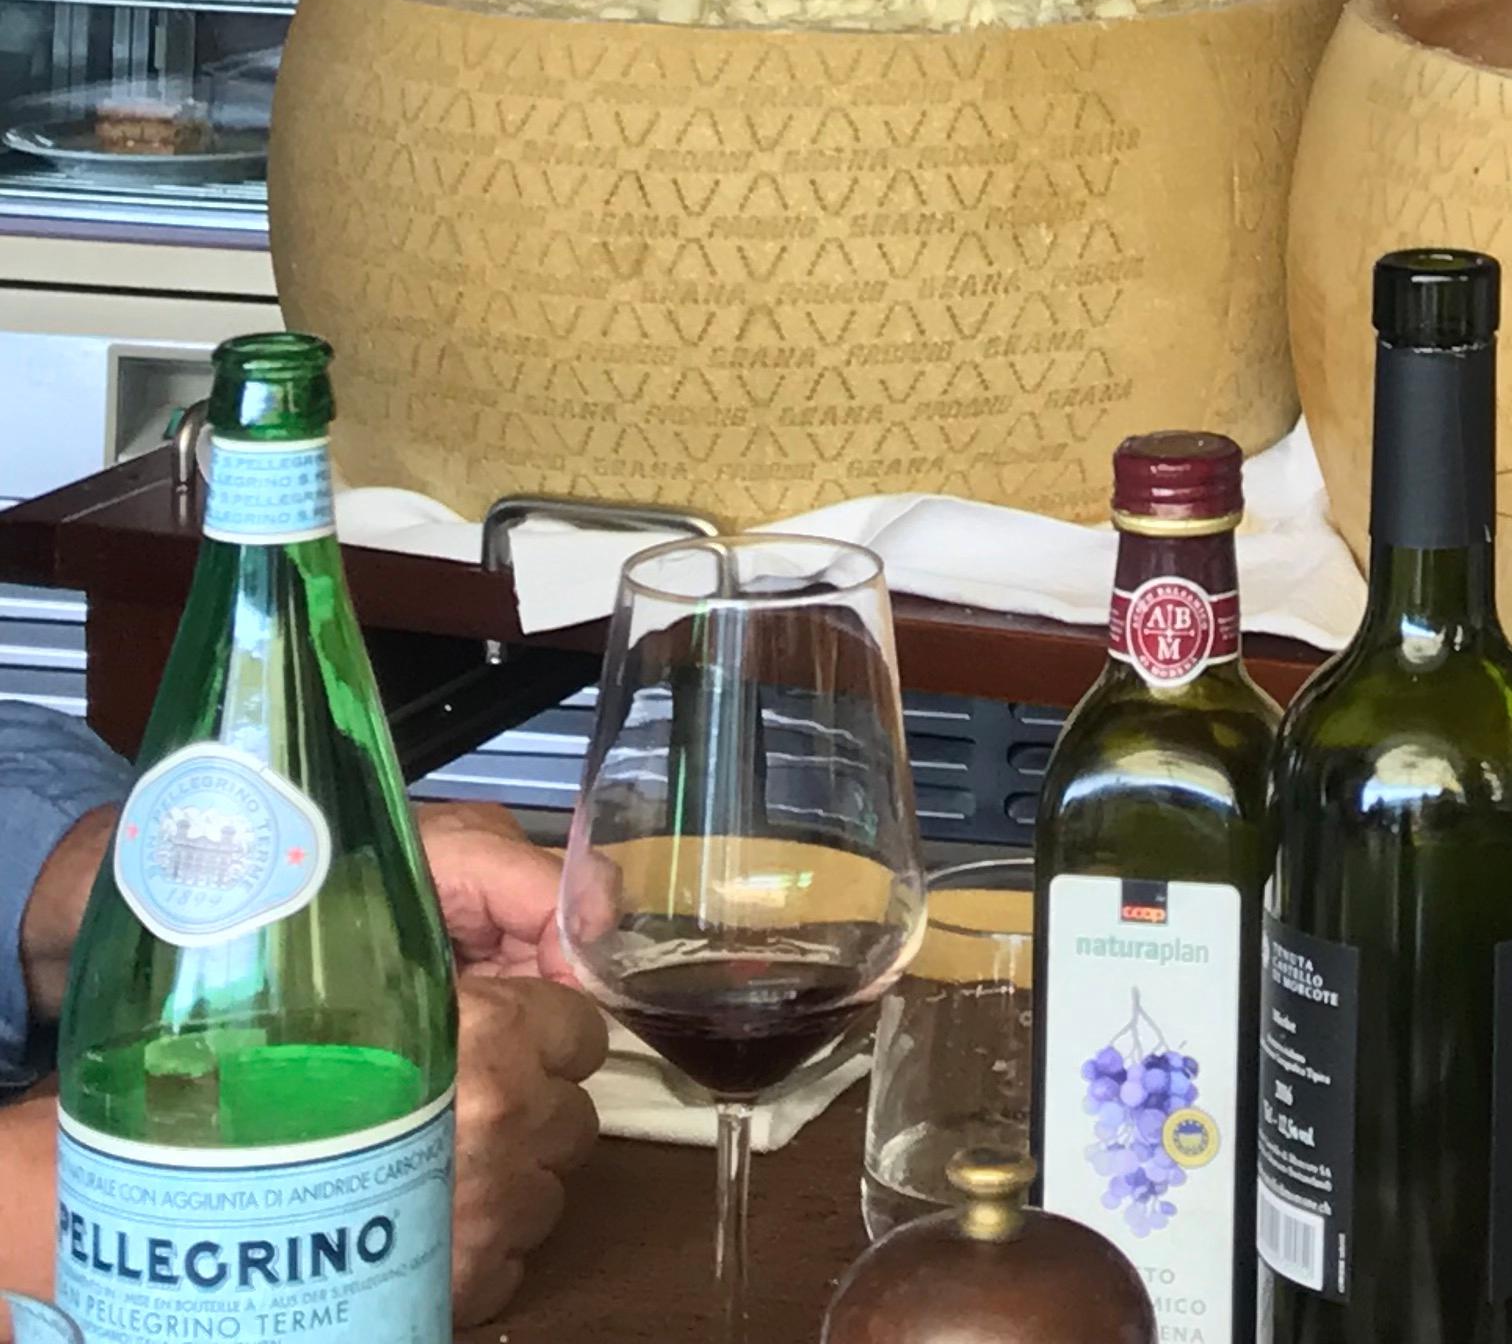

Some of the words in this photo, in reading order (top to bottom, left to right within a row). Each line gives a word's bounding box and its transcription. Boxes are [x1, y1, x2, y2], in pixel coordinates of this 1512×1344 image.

[1122, 904, 1166, 923] coop
[1075, 935, 1209, 967] naturaplan
[119, 1183, 156, 1206] CON
[161, 1190, 260, 1211] AGGIUNTA
[265, 1189, 283, 1209] DI
[287, 1170, 371, 1205] ANIDRIDE
[59, 1199, 394, 1290] PELLEGRINO
[86, 1293, 241, 1340] PELLEGRINO
[255, 1299, 350, 1336] TERME
